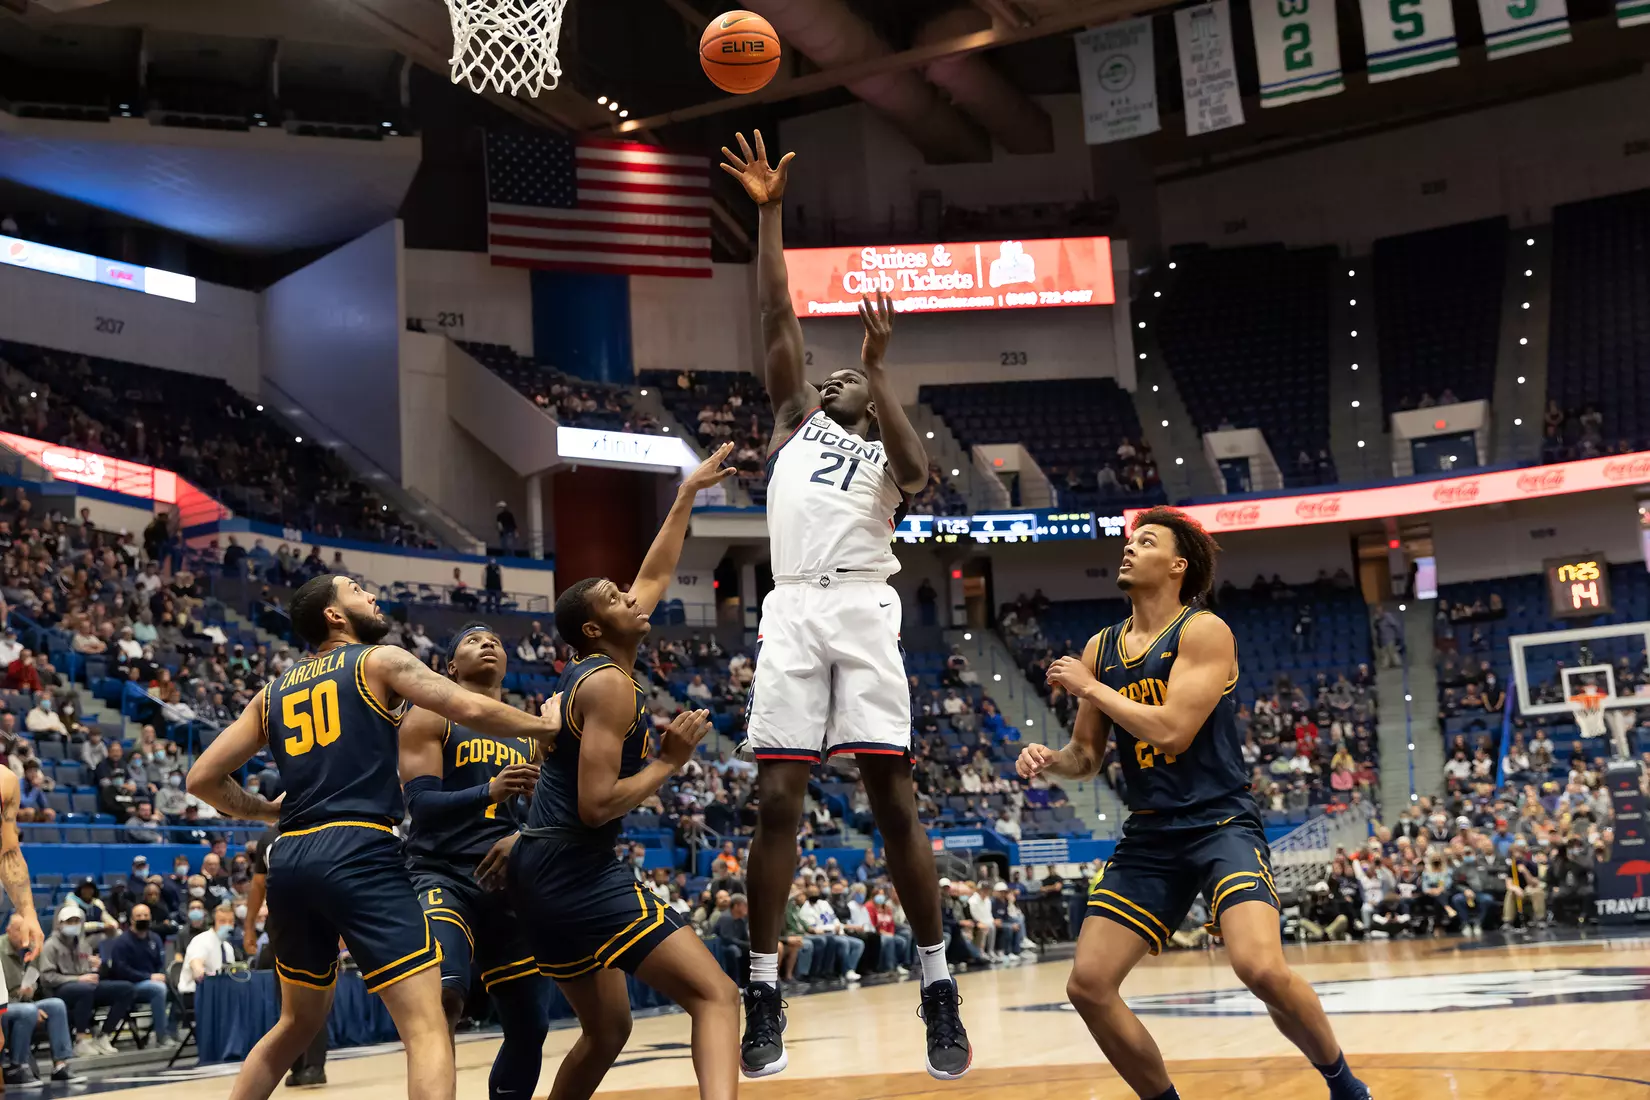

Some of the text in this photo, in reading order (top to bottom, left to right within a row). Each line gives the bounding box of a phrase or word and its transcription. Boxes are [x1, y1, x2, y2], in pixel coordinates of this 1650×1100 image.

[721, 40, 765, 53] ELITE
[1282, 22, 1312, 71] 2
[861, 244, 953, 270] Suites &
[842, 268, 974, 294] Club Tickets
[95, 316, 125, 335] 207
[438, 312, 464, 327] 231
[1001, 352, 1028, 366] 233
[810, 452, 861, 491] 21
[677, 575, 698, 586] 107
[1571, 581, 1599, 609] 14
[279, 651, 345, 692] ZARZUELA
[282, 679, 341, 757] 50
[428, 888, 443, 905] C
[1594, 896, 1650, 916] TRAVE
